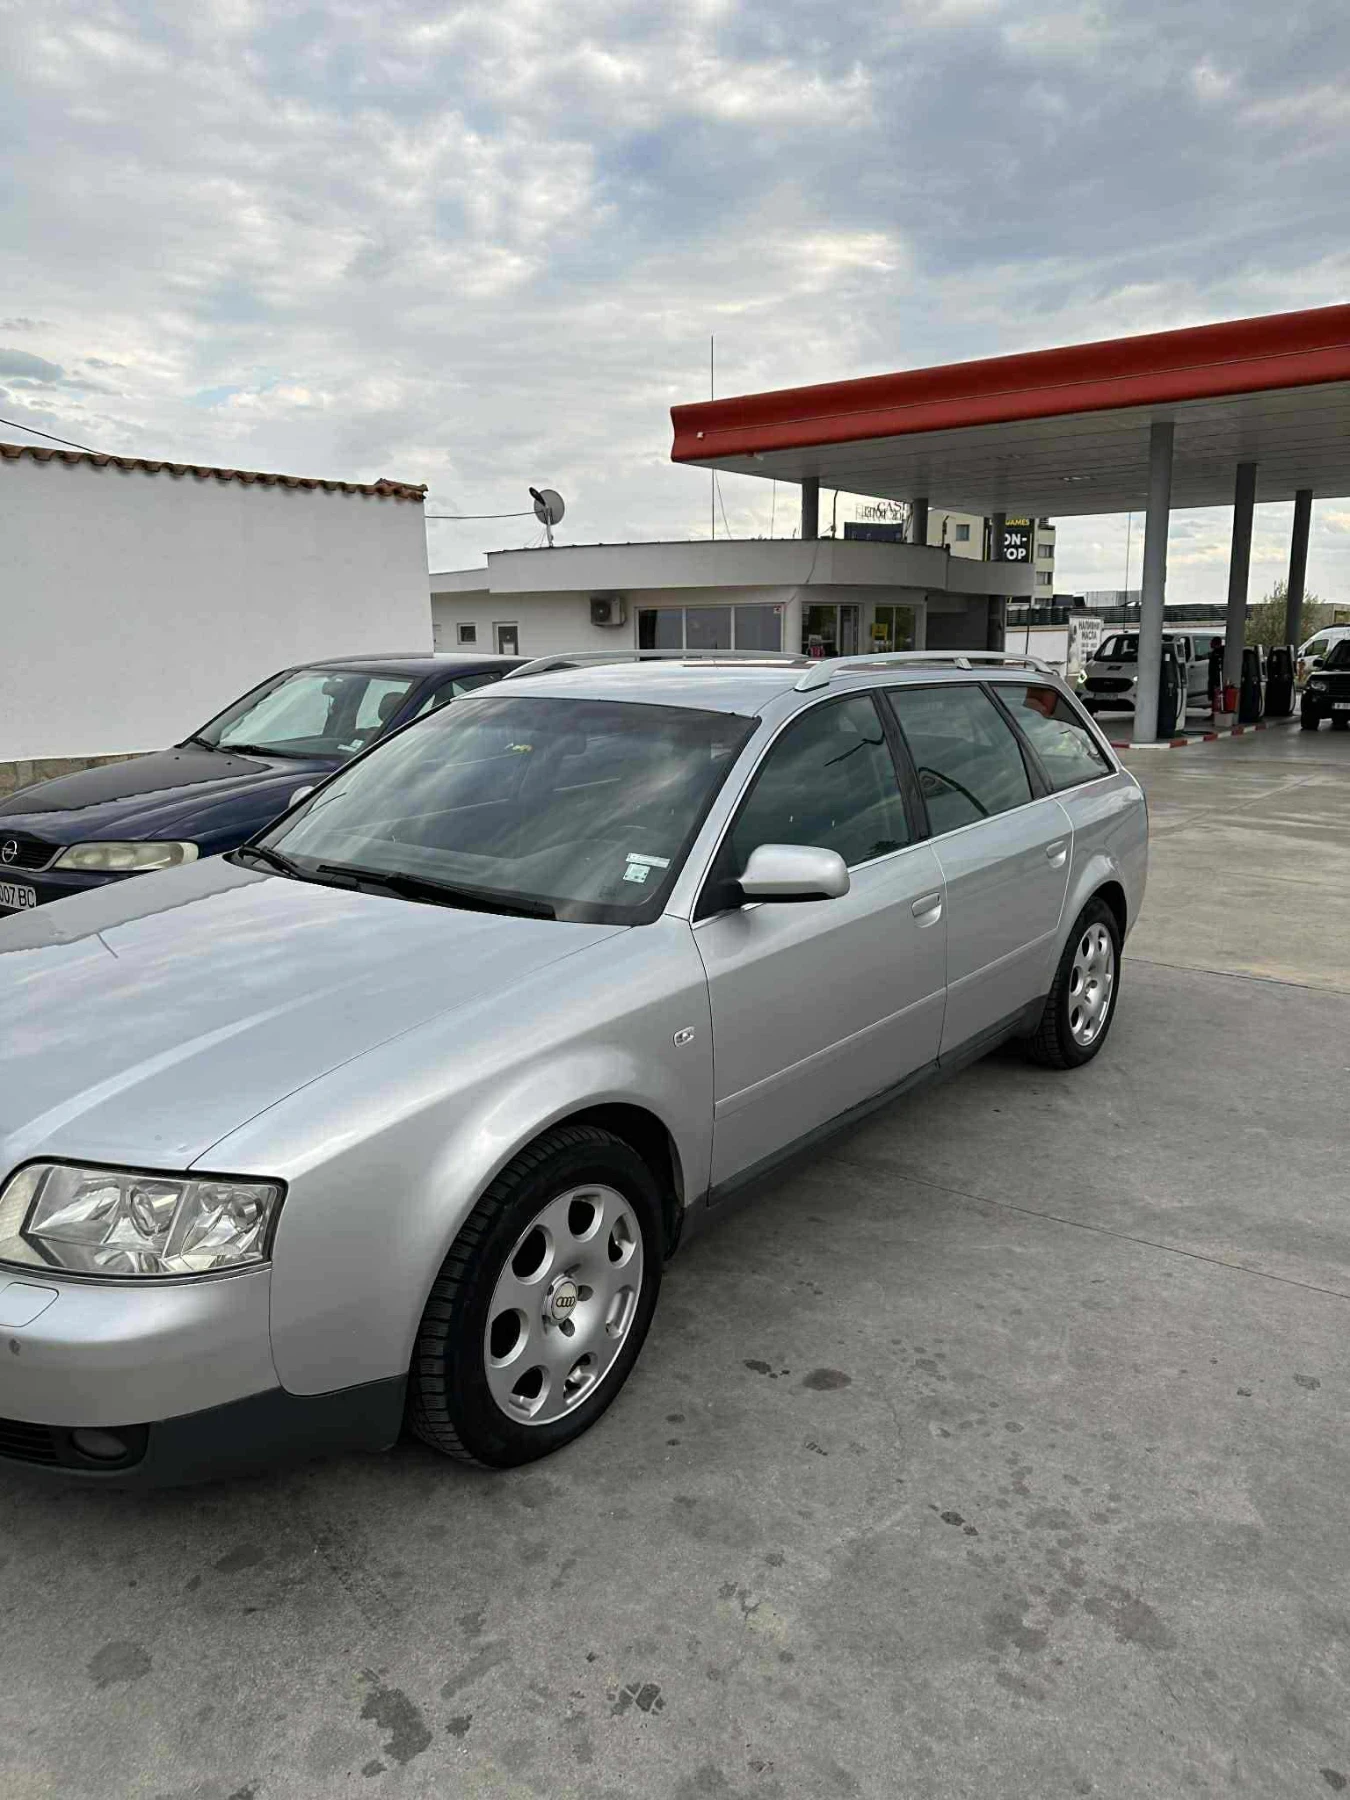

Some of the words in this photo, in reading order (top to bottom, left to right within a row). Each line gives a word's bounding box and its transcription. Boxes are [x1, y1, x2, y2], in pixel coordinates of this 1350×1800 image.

[1004, 533, 1028, 545] ON-
[1004, 548, 1027, 560] OP
[18, 888, 35, 908] BC
